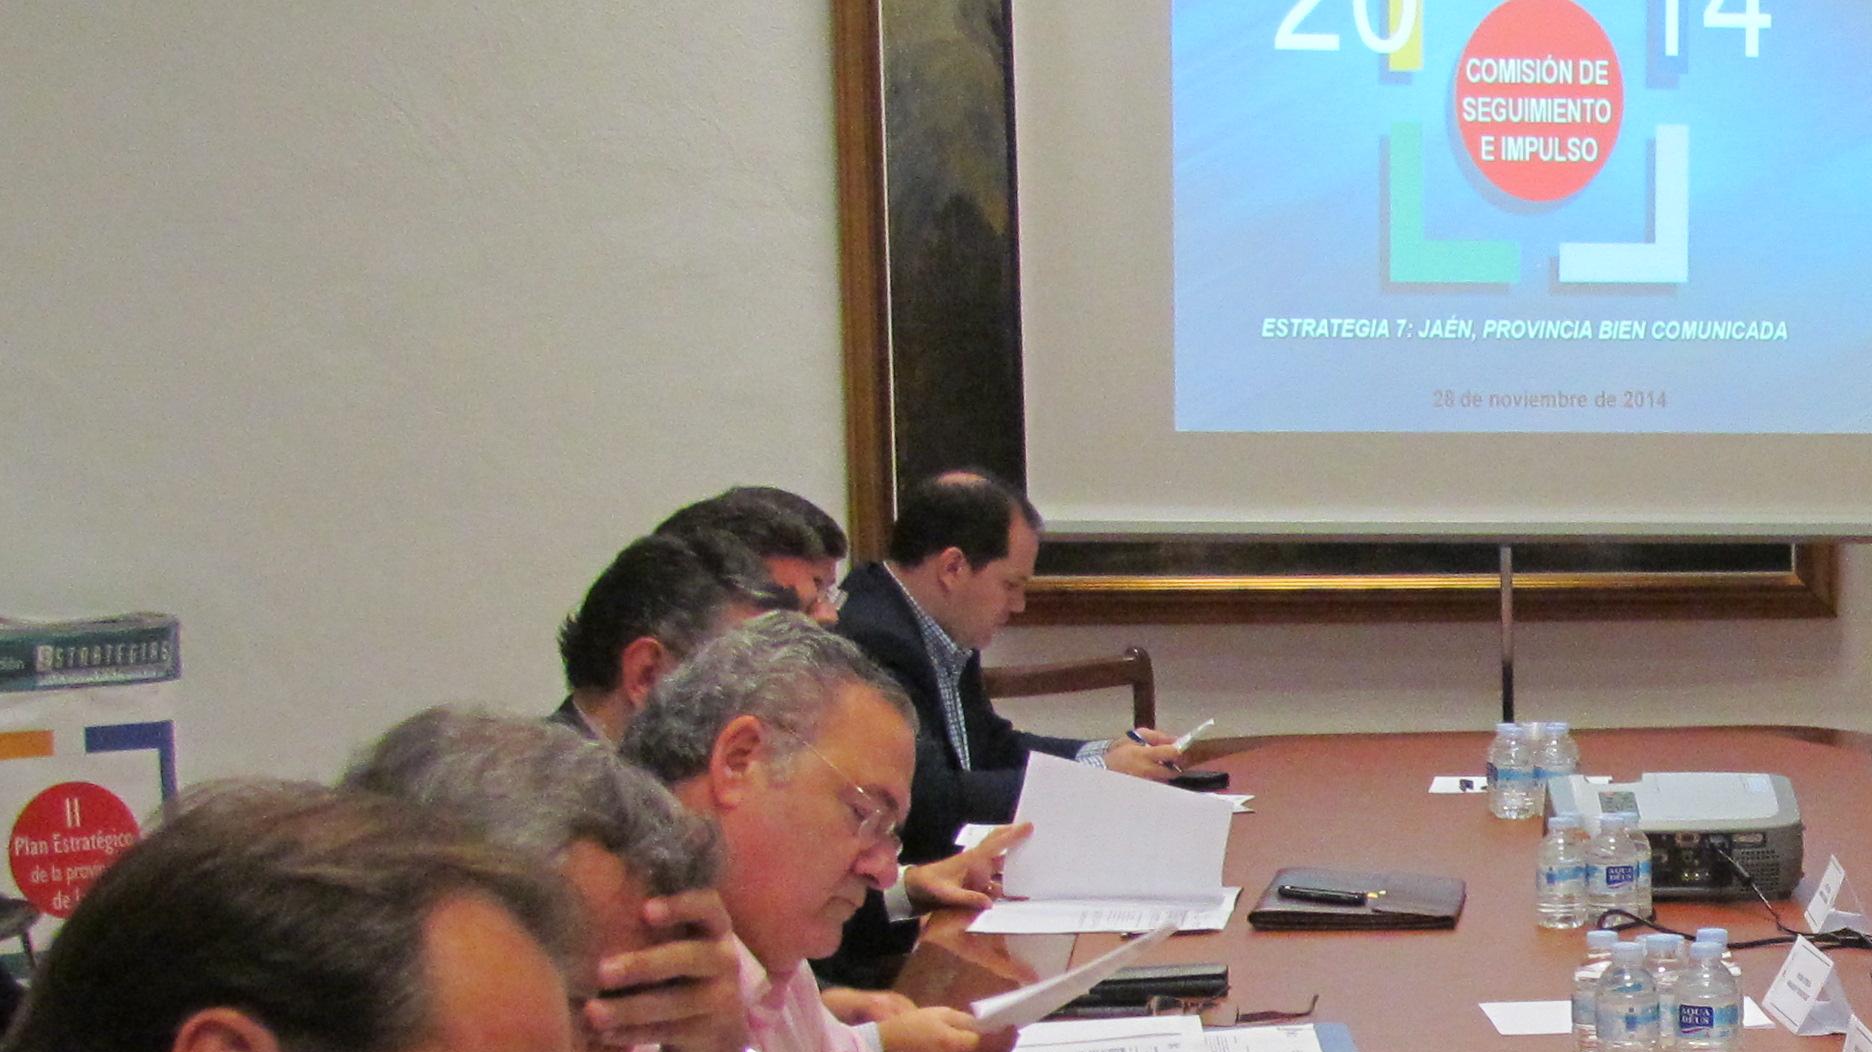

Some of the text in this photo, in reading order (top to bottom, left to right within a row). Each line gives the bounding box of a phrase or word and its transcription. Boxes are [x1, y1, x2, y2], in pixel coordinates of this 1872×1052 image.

[1466, 54, 1609, 85] COMISIÓN DE
[1462, 97, 1611, 123] SEGUIMIENTO
[1481, 136, 1598, 162] E IMPULSO
[1261, 315, 1789, 342] ESTRATEGIA 7: JAÉN, PROVINCIA BIEN COMUNICADA
[1433, 390, 1667, 409] 28 de noviembre de 2014
[65, 797, 80, 828] II
[15, 829, 133, 856] Plan Estratégico
[31, 865, 48, 883] de
[51, 864, 62, 881] la
[52, 890, 71, 910] de
[1681, 1005, 1710, 1016] AQUA
[1681, 1015, 1710, 1024] DEUS
